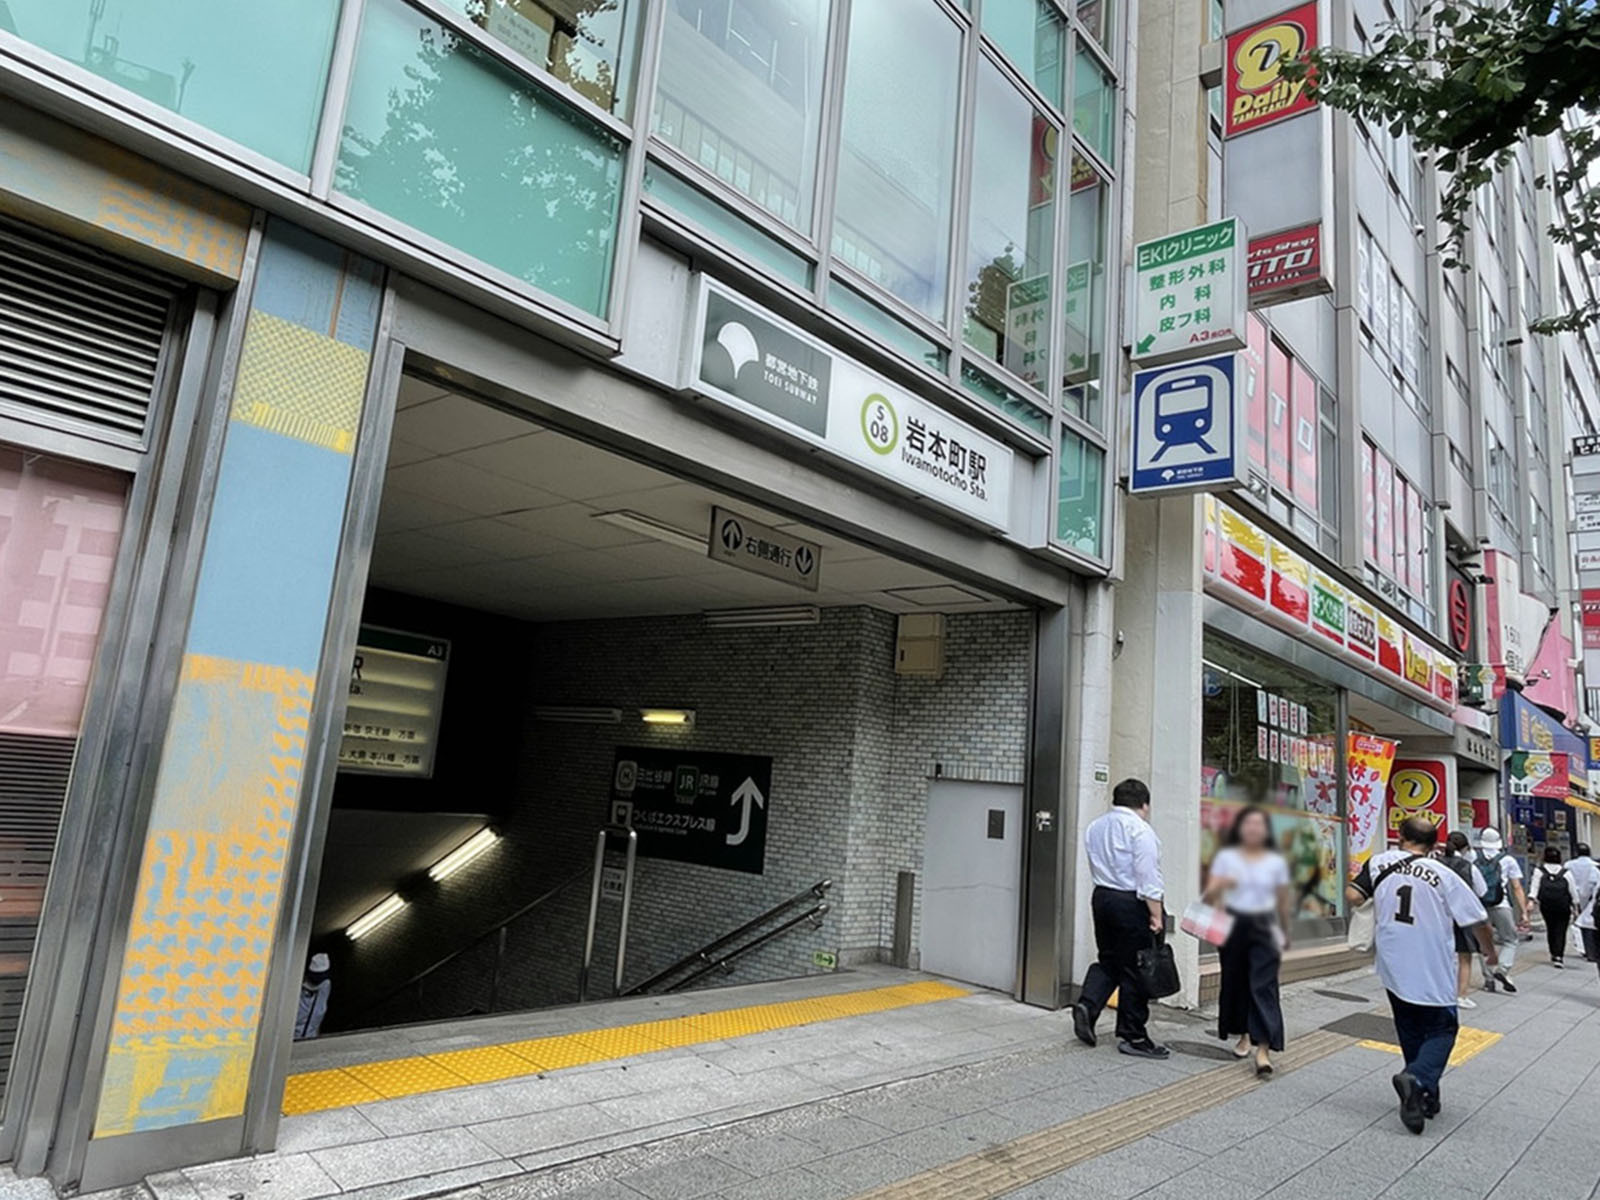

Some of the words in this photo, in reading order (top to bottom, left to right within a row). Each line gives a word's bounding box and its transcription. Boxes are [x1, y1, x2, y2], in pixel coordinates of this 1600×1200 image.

[1232, 78, 1306, 116] Daily
[1139, 227, 1233, 267] EKIクリニック
[1149, 257, 1226, 291] 整形外科
[1248, 271, 1301, 288] KIHABARA
[1159, 307, 1211, 333] 皮フ科
[765, 353, 818, 393] 都営地下鉄
[783, 380, 818, 405] SUBWAY
[876, 404, 886, 422] S
[870, 420, 889, 444] 08
[905, 415, 987, 485] 岩本町駅
[901, 446, 968, 492] Iwamotocho
[968, 480, 988, 502] Sta.
[745, 535, 793, 569] 右側通行
[679, 774, 694, 790] JR
[633, 809, 717, 832] つくばエクスプレス線
[1394, 884, 1415, 925] 1
